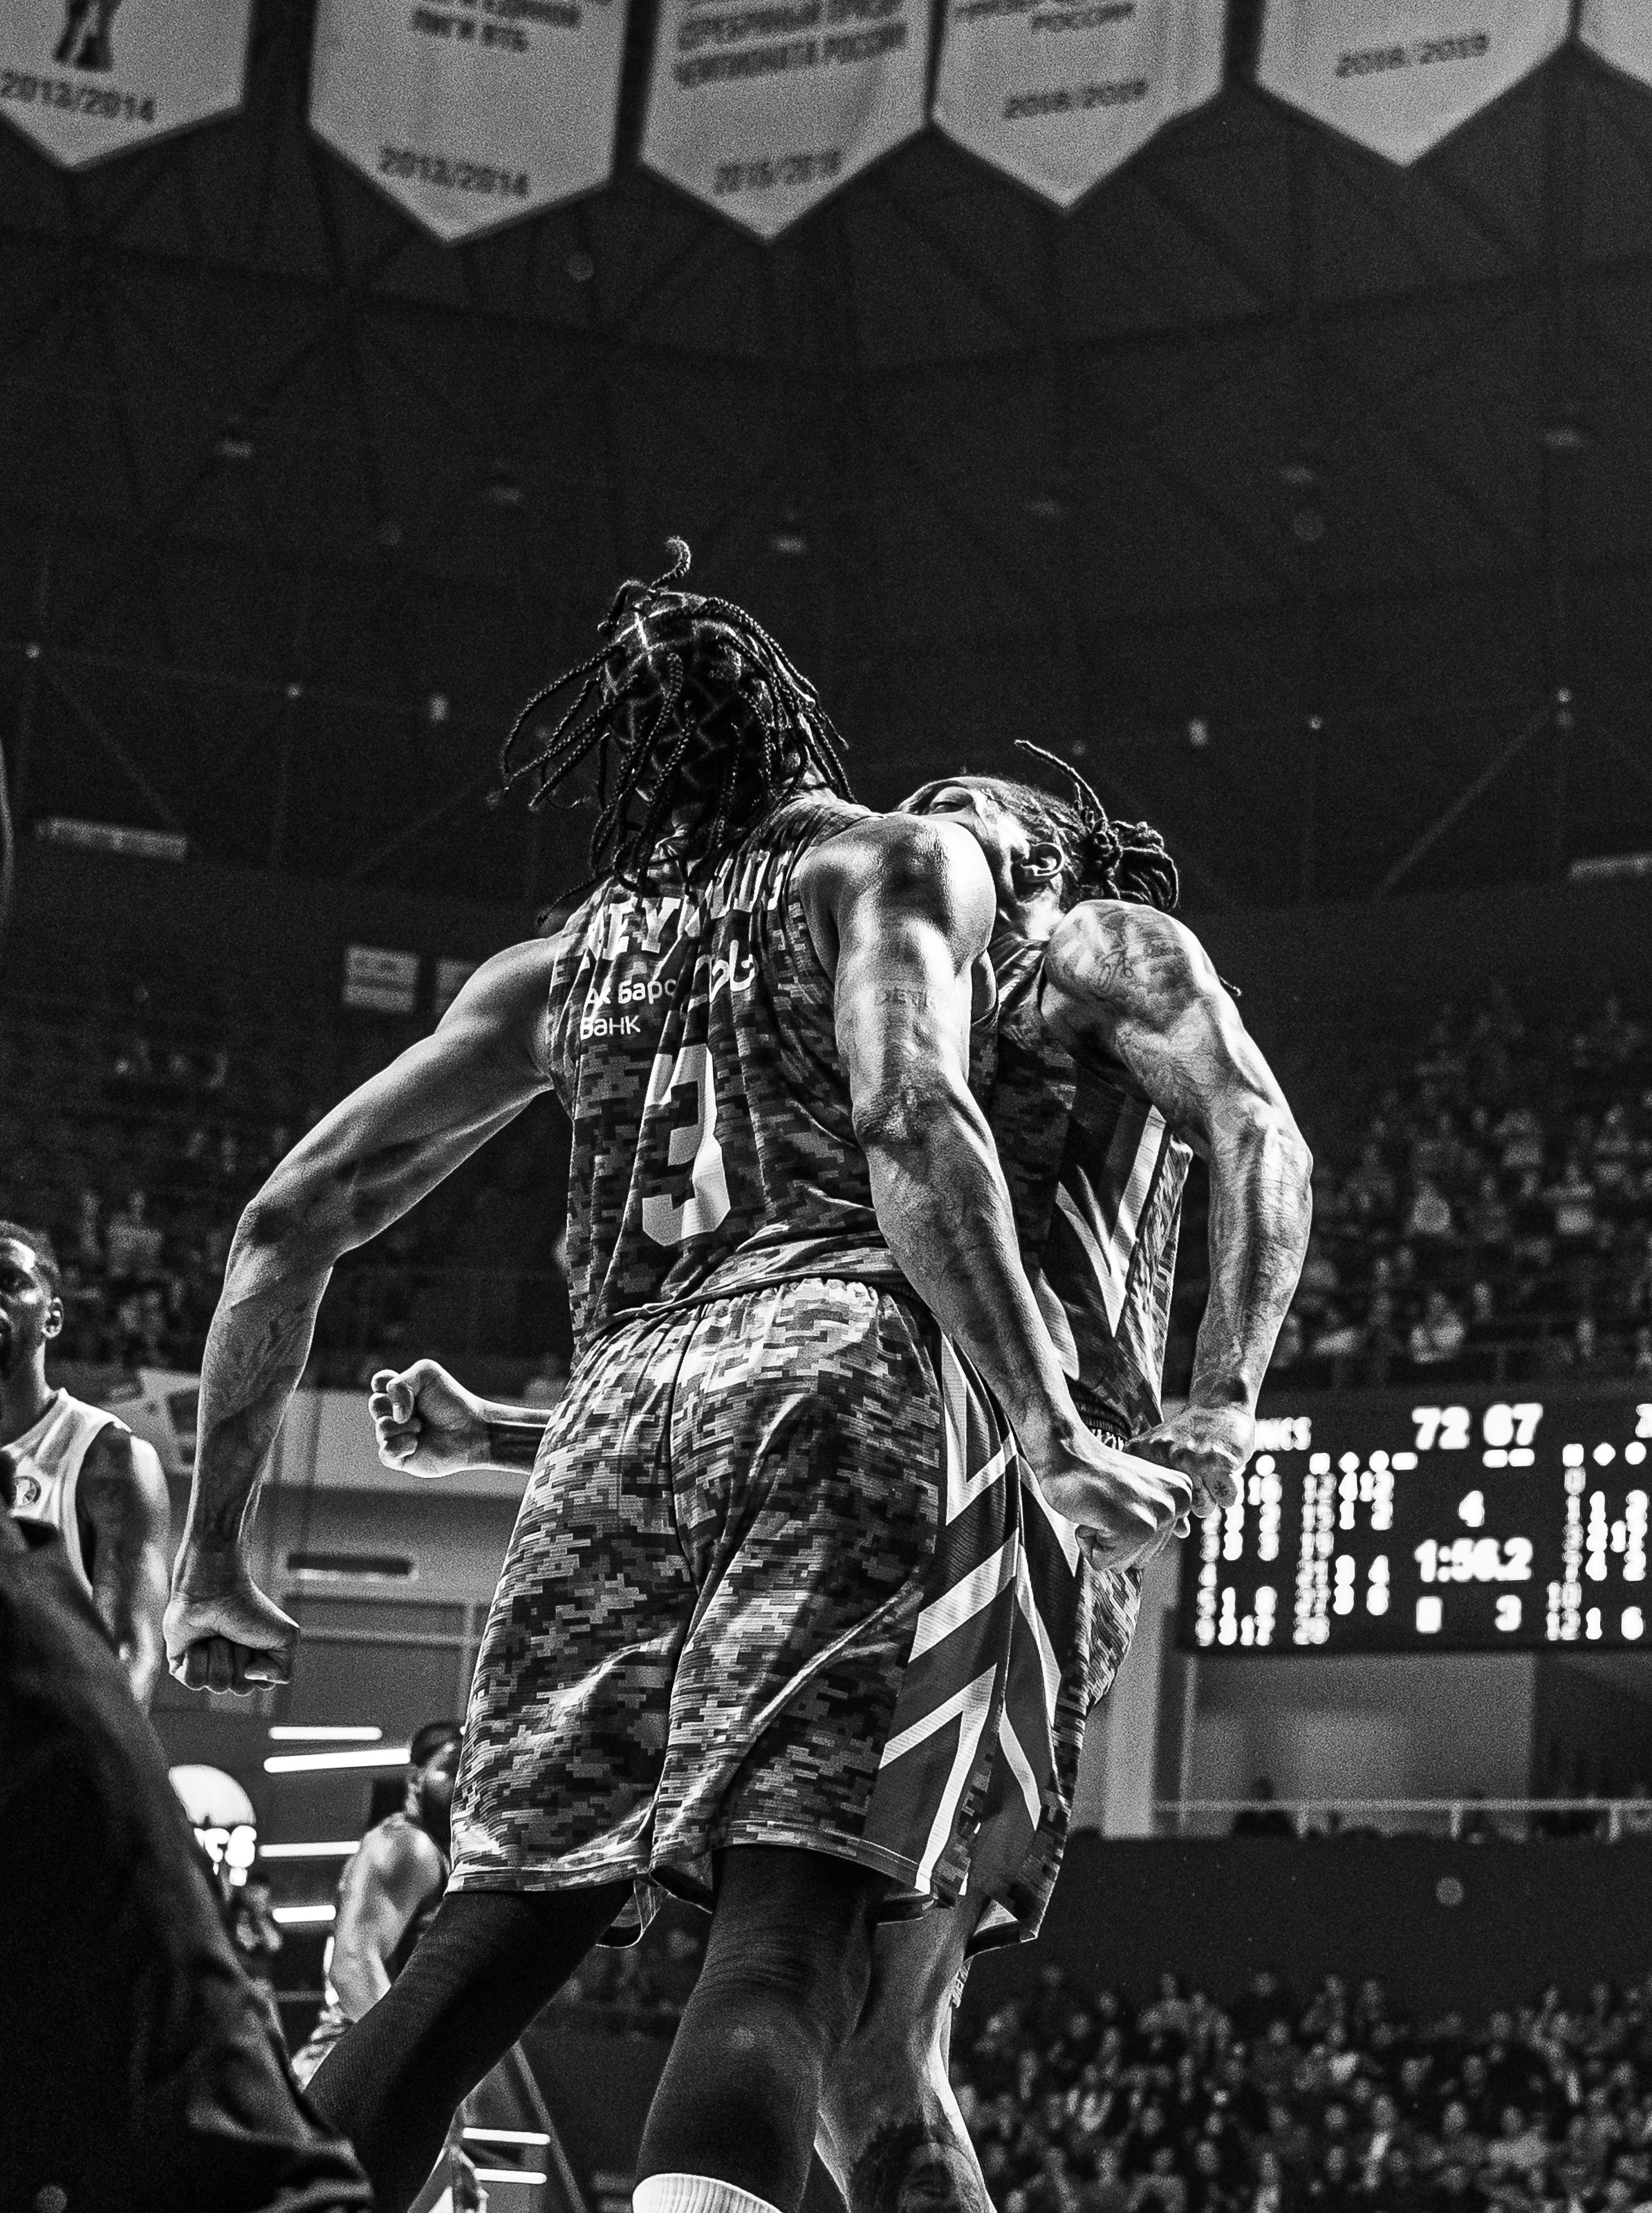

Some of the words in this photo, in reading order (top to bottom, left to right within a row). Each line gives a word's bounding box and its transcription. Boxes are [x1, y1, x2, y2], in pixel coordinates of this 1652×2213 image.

[642, 1043, 731, 1247] 3
[1412, 1405, 1471, 1450] 72
[1458, 1490, 1485, 1528] 4
